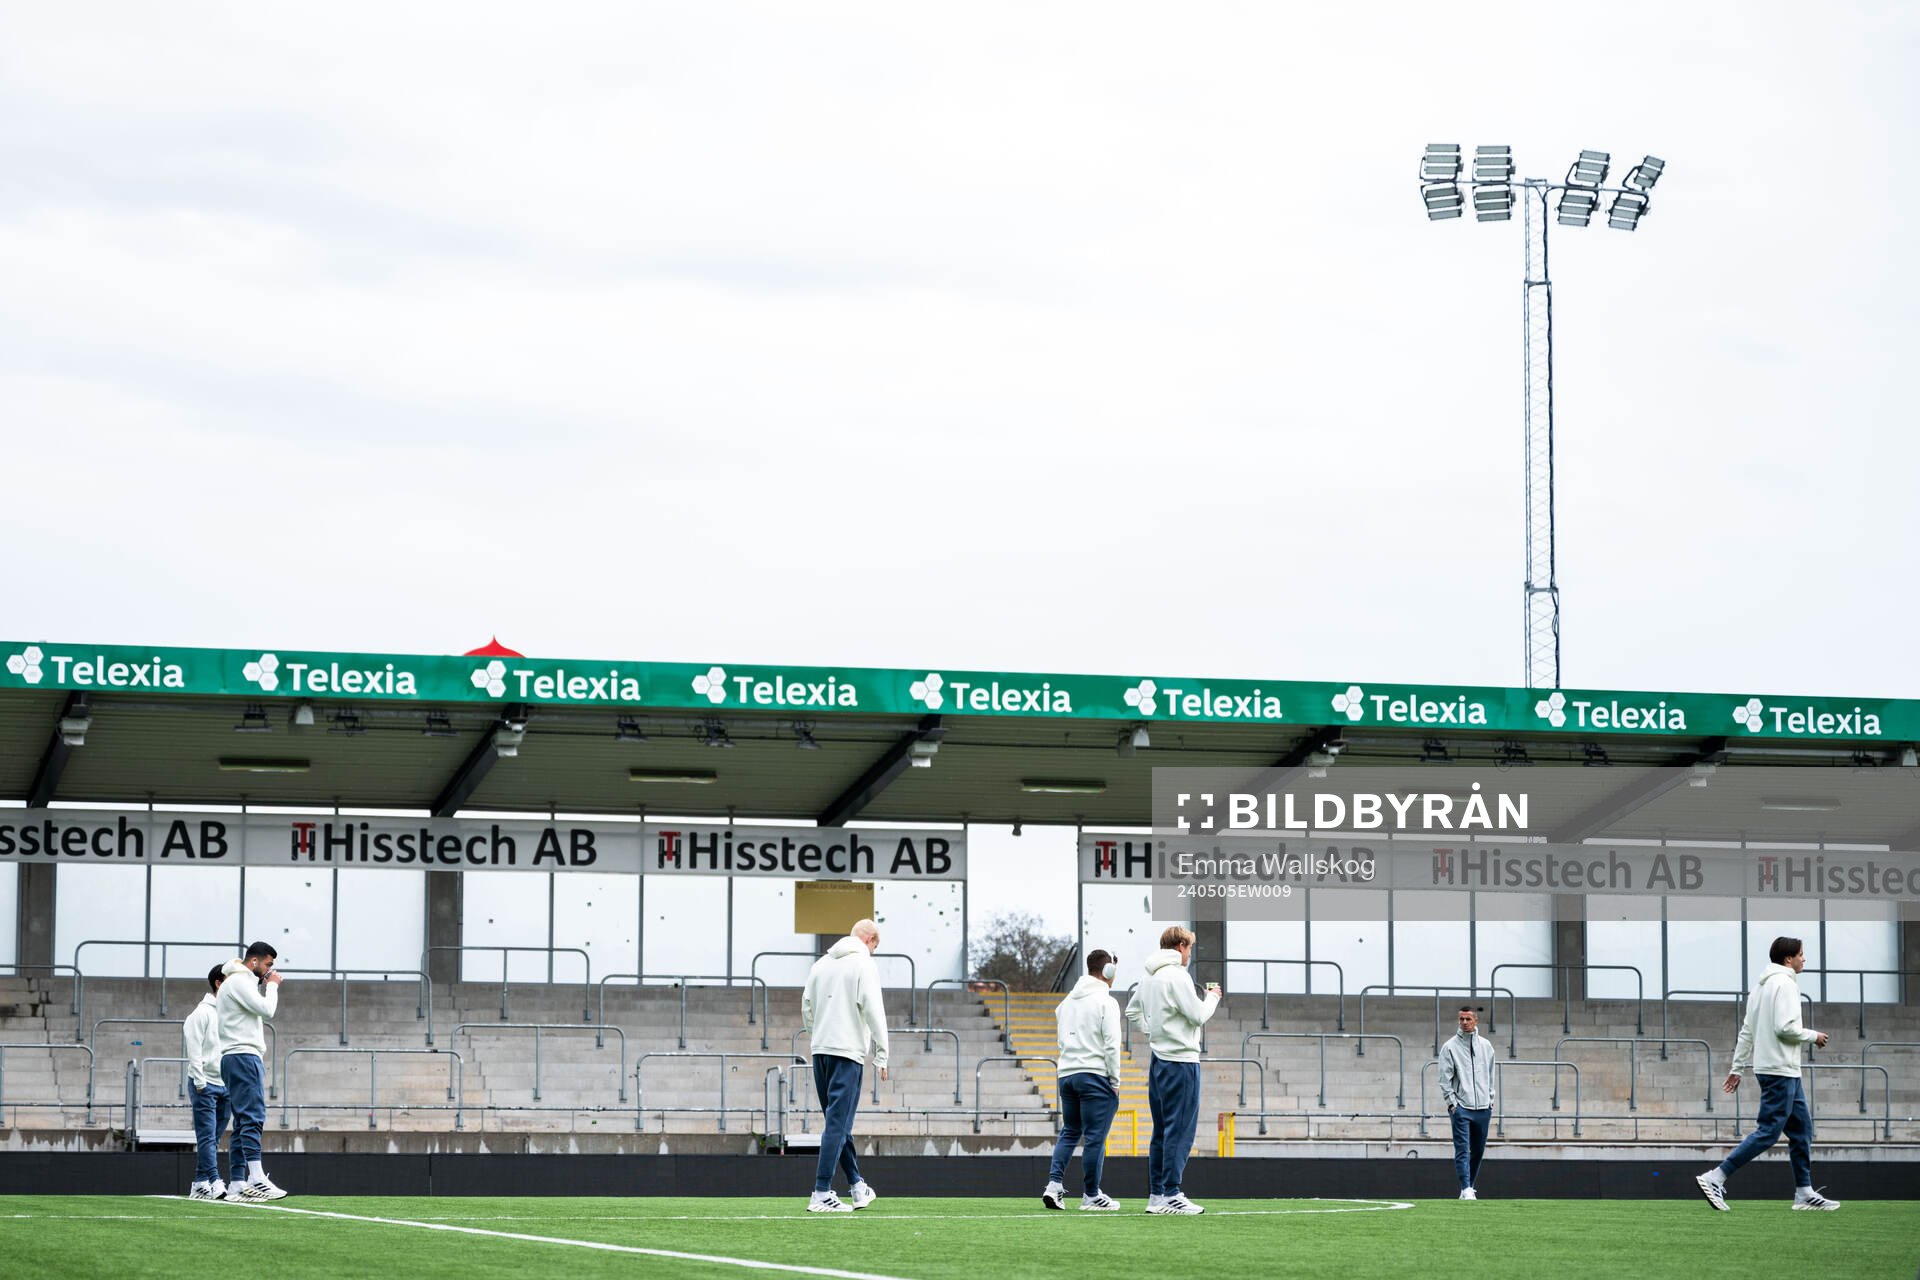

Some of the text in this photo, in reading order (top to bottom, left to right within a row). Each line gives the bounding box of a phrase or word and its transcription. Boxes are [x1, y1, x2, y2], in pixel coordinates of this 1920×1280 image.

[51, 656, 184, 687] Telexia
[287, 663, 416, 694] Telexia
[514, 670, 640, 700] Telexia
[734, 676, 857, 706] Telexia
[951, 682, 1072, 712] Telexia
[1164, 689, 1282, 718] Telexia
[1371, 695, 1486, 724] Telexia
[1573, 701, 1686, 729] Telexia
[1770, 707, 1881, 734] Telexia
[161, 820, 228, 859] AB
[323, 822, 516, 865] Hisstech
[532, 828, 597, 866] AB
[689, 831, 874, 874] Hisstech
[890, 837, 951, 875] AB
[1316, 846, 1375, 883] AB
[1461, 849, 1632, 888] Hisstech
[1646, 854, 1704, 890] AB
